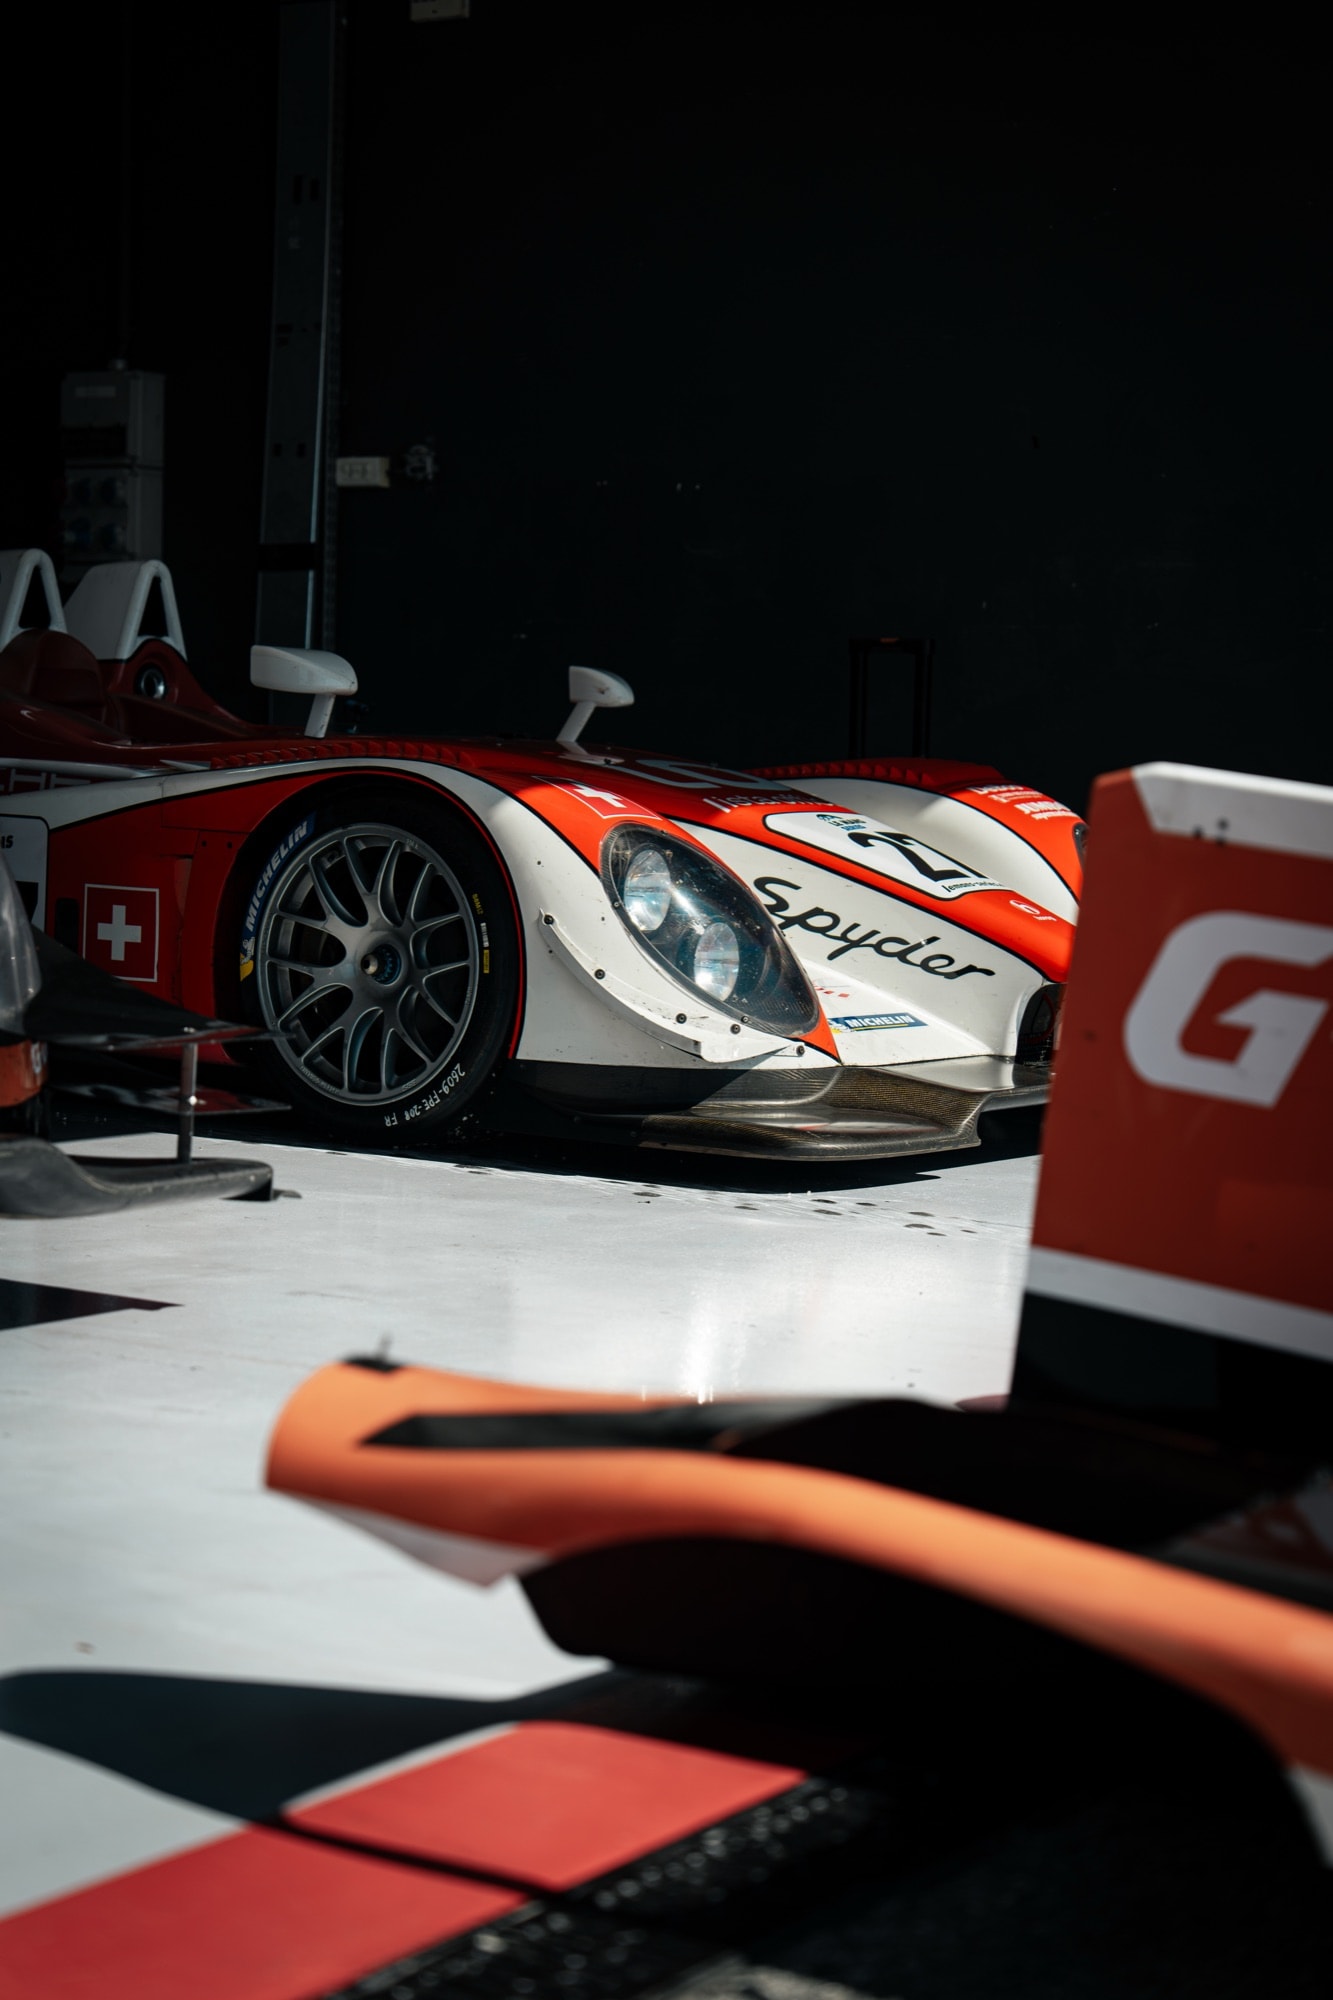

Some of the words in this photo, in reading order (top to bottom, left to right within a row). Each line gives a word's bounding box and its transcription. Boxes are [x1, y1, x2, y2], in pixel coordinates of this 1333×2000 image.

[245, 820, 308, 932] MICHELIN
[753, 876, 996, 980] Spyder
[845, 1015, 916, 1028] MICHELIN
[384, 1112, 399, 1127] FR
